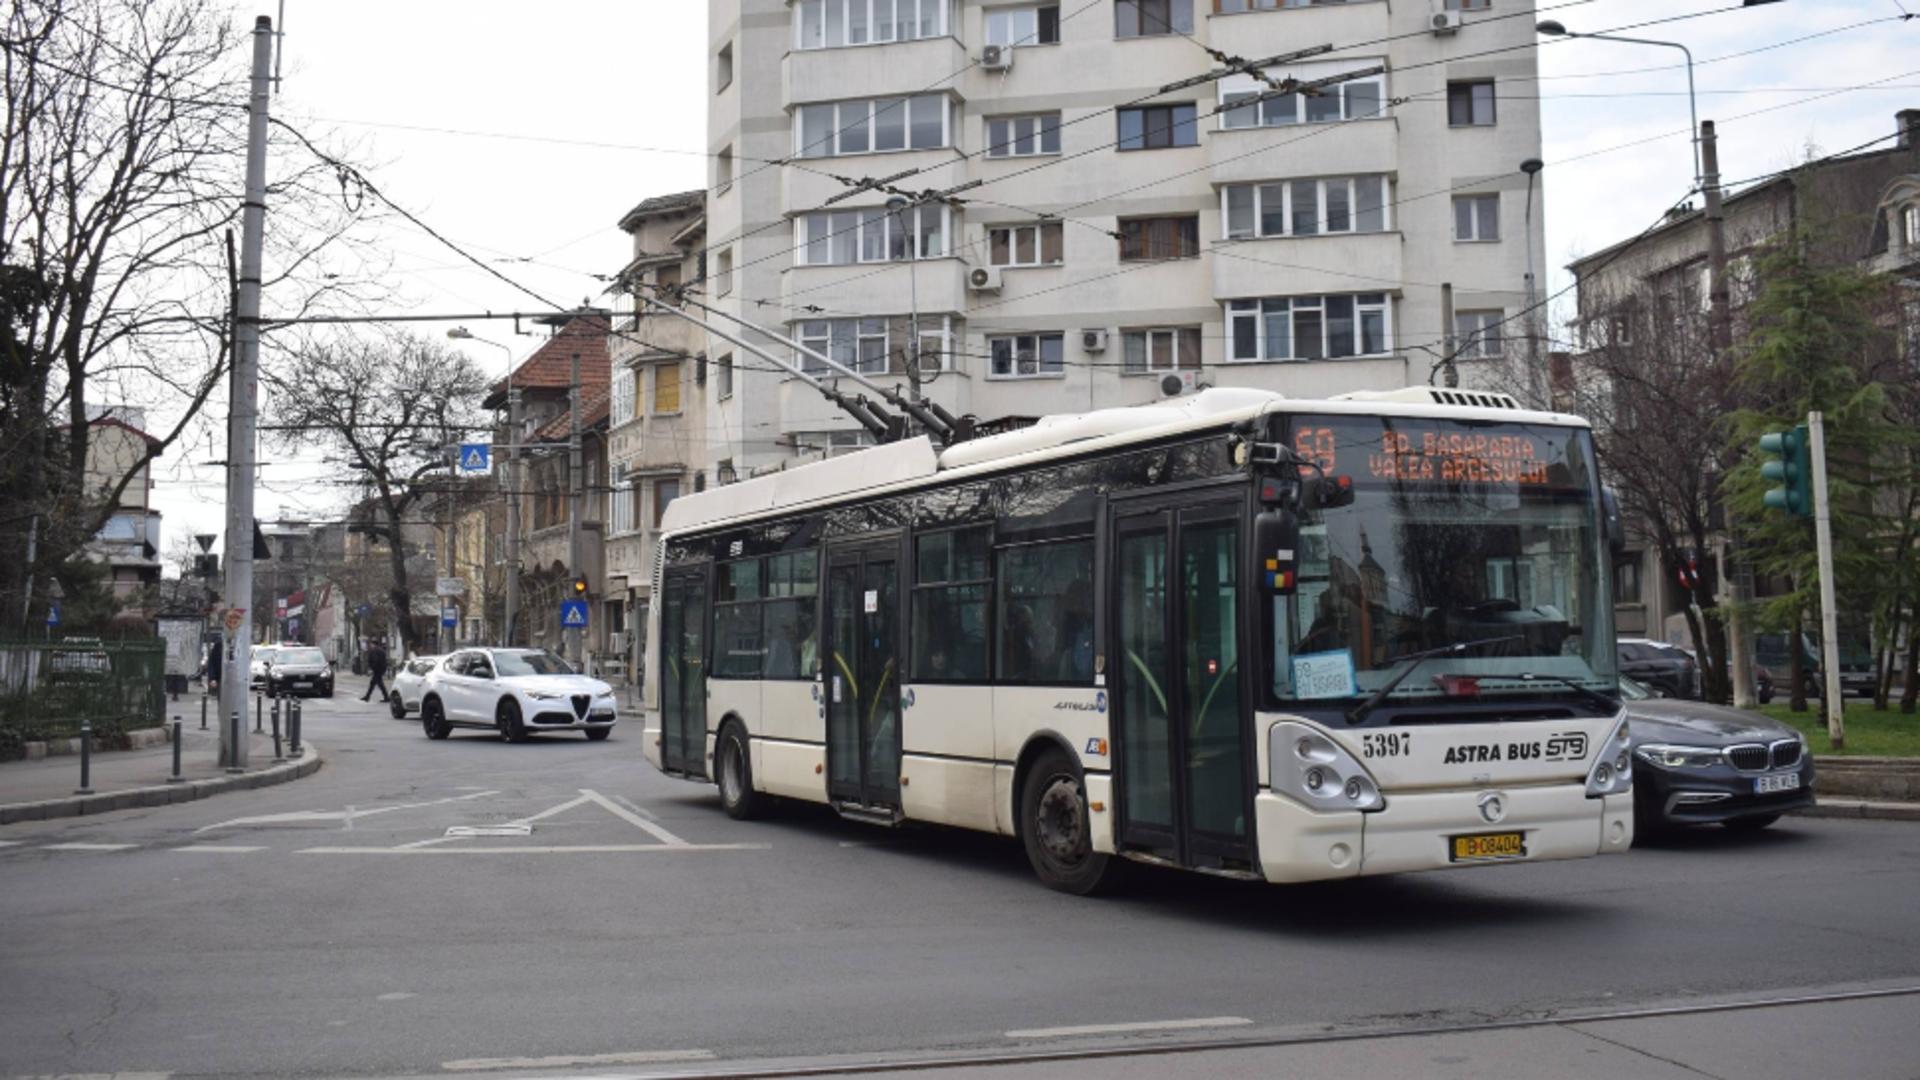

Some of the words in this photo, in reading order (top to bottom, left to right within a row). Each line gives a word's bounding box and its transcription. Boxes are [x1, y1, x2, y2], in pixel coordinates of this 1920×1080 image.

[1423, 432, 1534, 459] BASARABIA
[1368, 454, 1434, 480] VALEA
[1441, 458, 1549, 484] ARGESULUI
[1363, 732, 1411, 759] 5397
[1443, 745, 1501, 764] ASTRA
[1507, 742, 1541, 761] BUS
